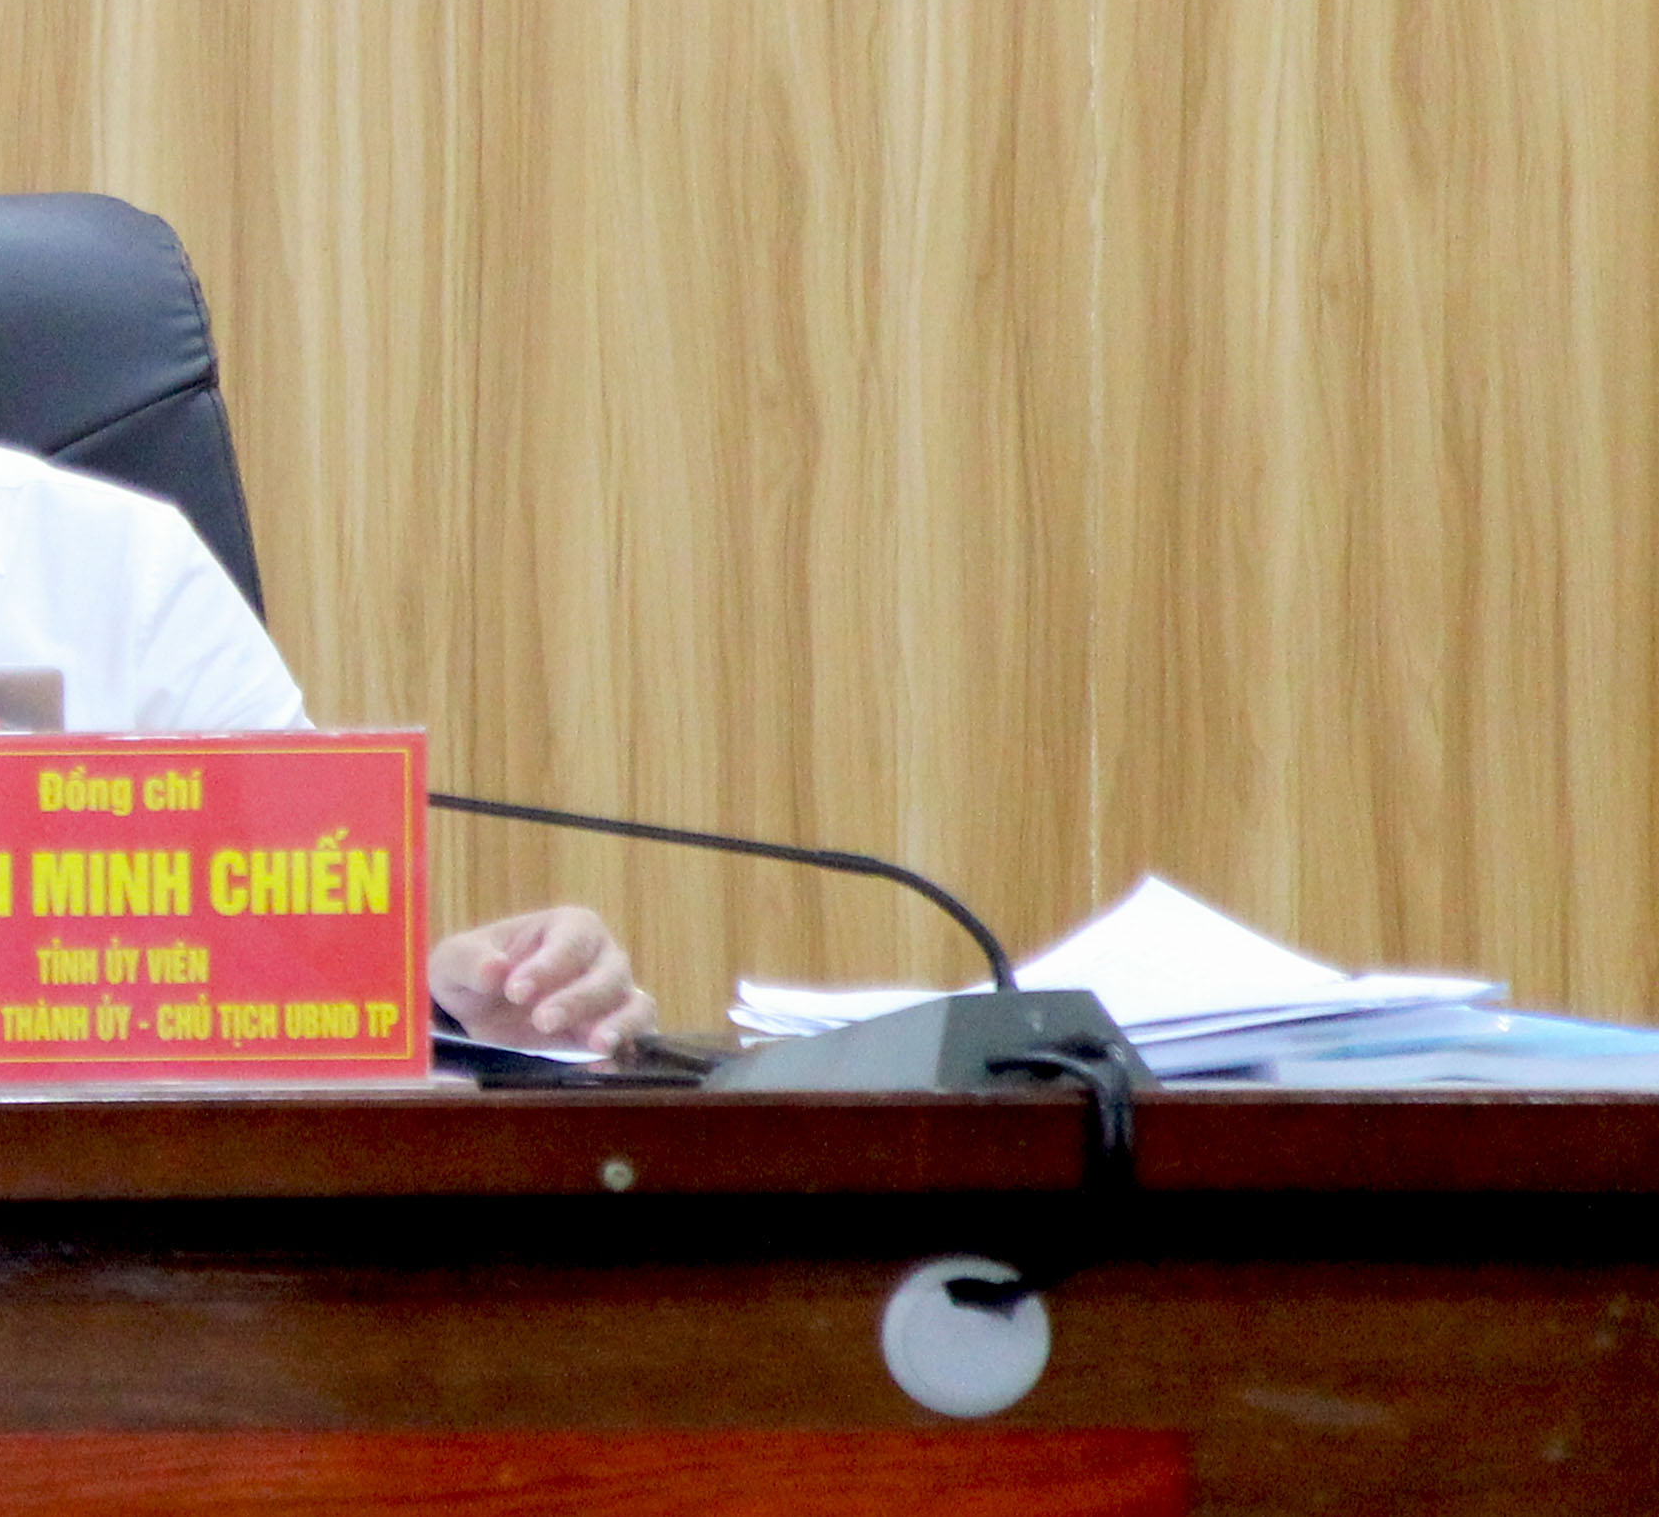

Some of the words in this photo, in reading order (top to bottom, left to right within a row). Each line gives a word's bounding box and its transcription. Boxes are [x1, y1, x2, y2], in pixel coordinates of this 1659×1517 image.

[39, 765, 133, 817] Đồng
[143, 768, 203, 811] chí
[31, 849, 193, 917] MINH
[209, 828, 391, 916] CHIẾN
[36, 937, 99, 985] TỈNH
[105, 937, 140, 985] ỦY
[146, 939, 209, 984] VIÊN
[1, 997, 90, 1041] THÀNH
[96, 993, 131, 1041] ỦY
[157, 992, 213, 1041] CHỦ
[217, 1002, 279, 1048] TỊCH
[284, 1000, 360, 1040] UBND
[364, 1001, 399, 1038] TP
